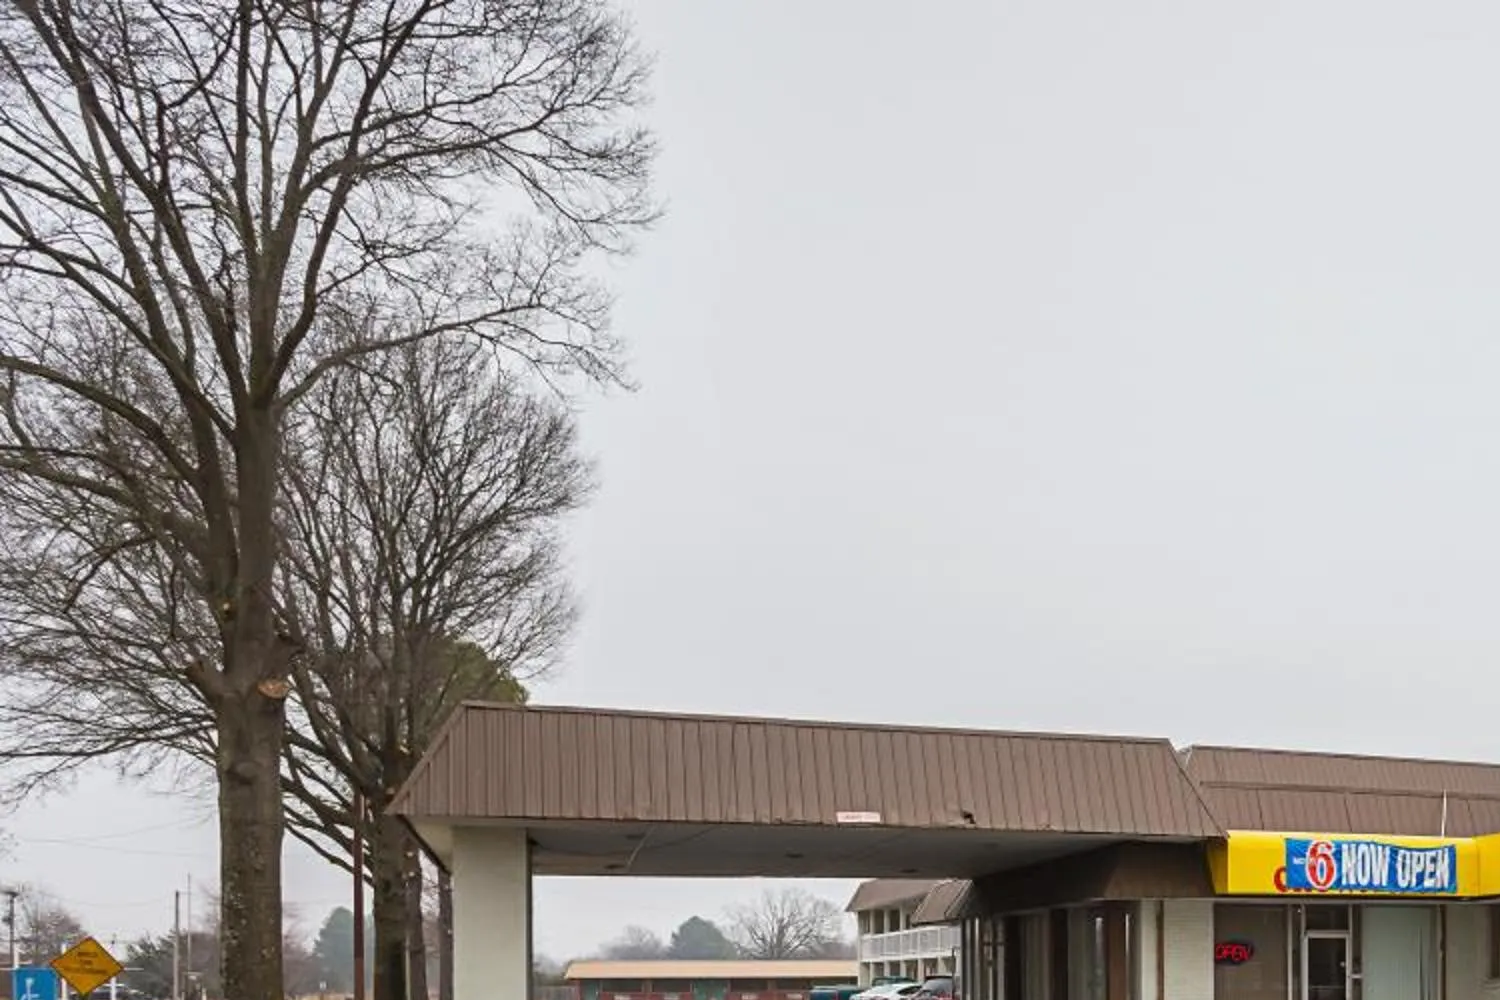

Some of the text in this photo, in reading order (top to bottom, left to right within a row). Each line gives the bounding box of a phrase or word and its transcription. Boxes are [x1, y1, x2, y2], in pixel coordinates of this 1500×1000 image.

[1306, 839, 1337, 889] 6
[1341, 843, 1391, 886] NOW
[1396, 848, 1450, 888] OPEN
